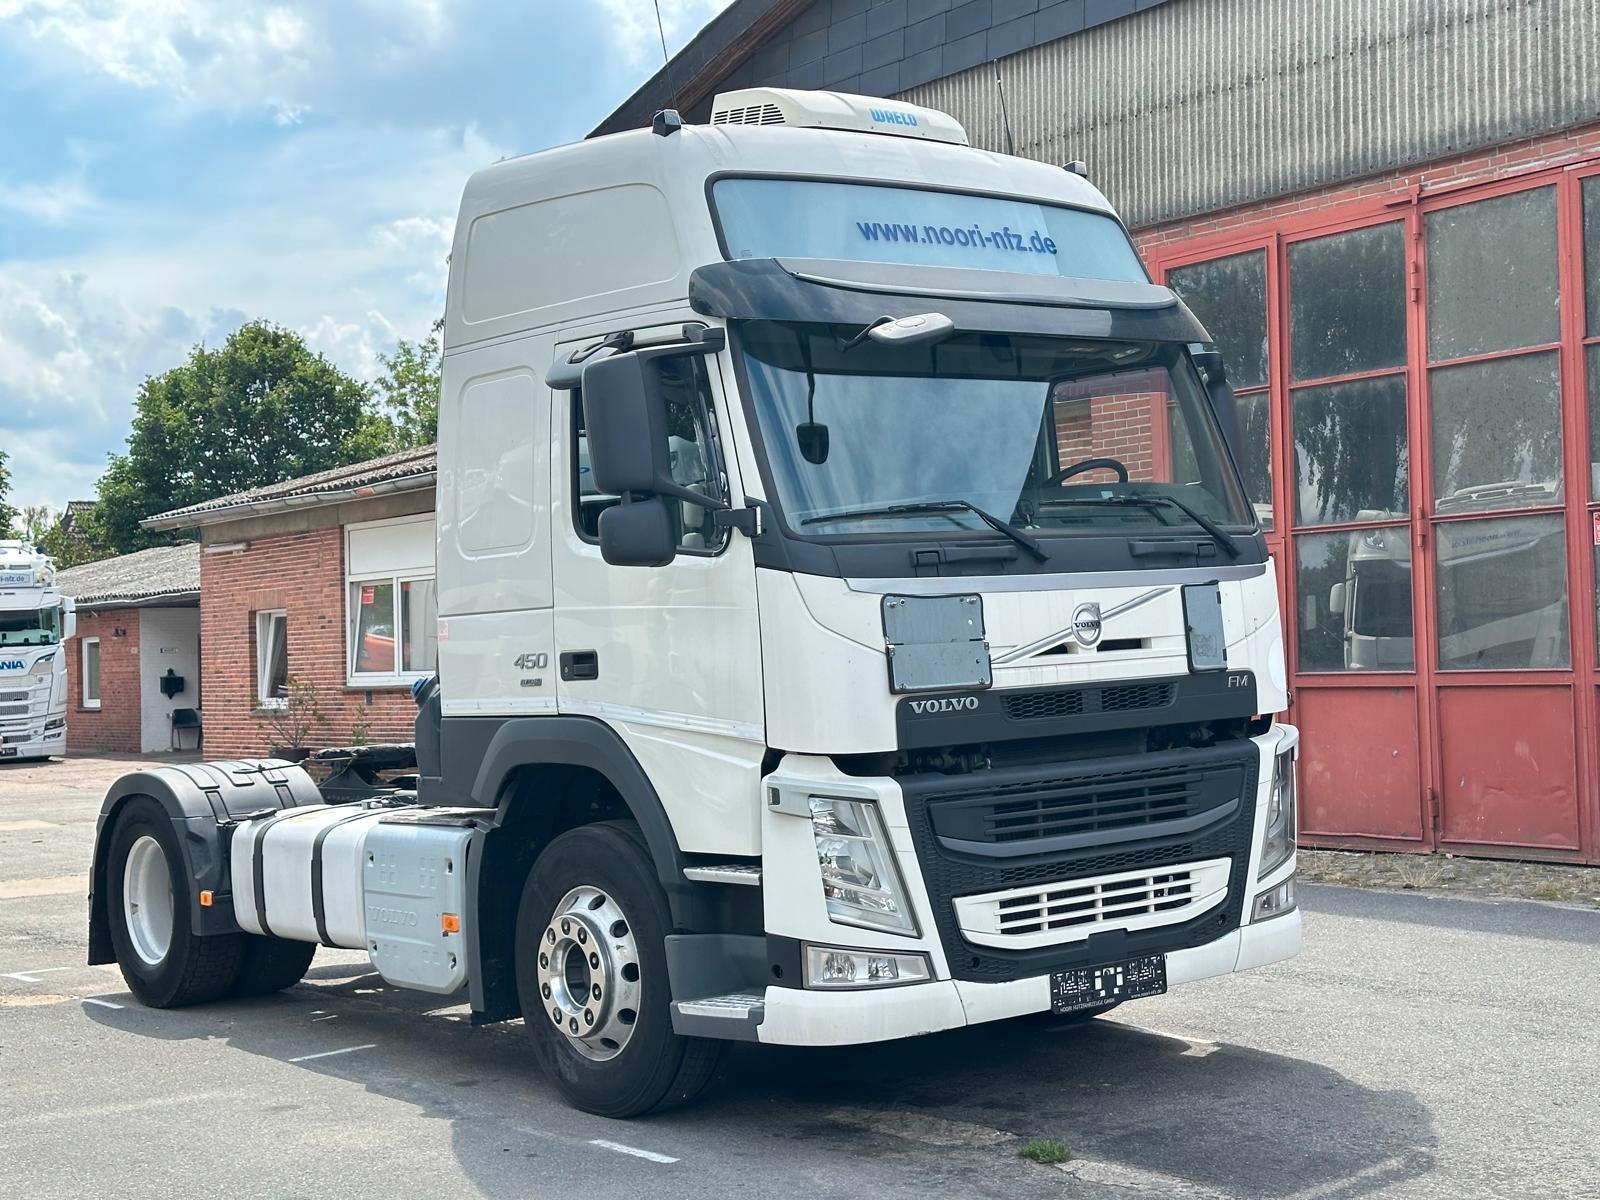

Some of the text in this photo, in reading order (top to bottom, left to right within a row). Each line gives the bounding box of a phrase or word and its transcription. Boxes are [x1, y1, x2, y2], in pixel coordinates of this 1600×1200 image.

[868, 108, 918, 127] WAECO
[855, 221, 1058, 255] www.noori-nfz.de
[513, 652, 548, 670] 450
[1228, 674, 1249, 688] FM
[908, 696, 980, 714] VOLVO
[367, 905, 418, 928] VOLVO
